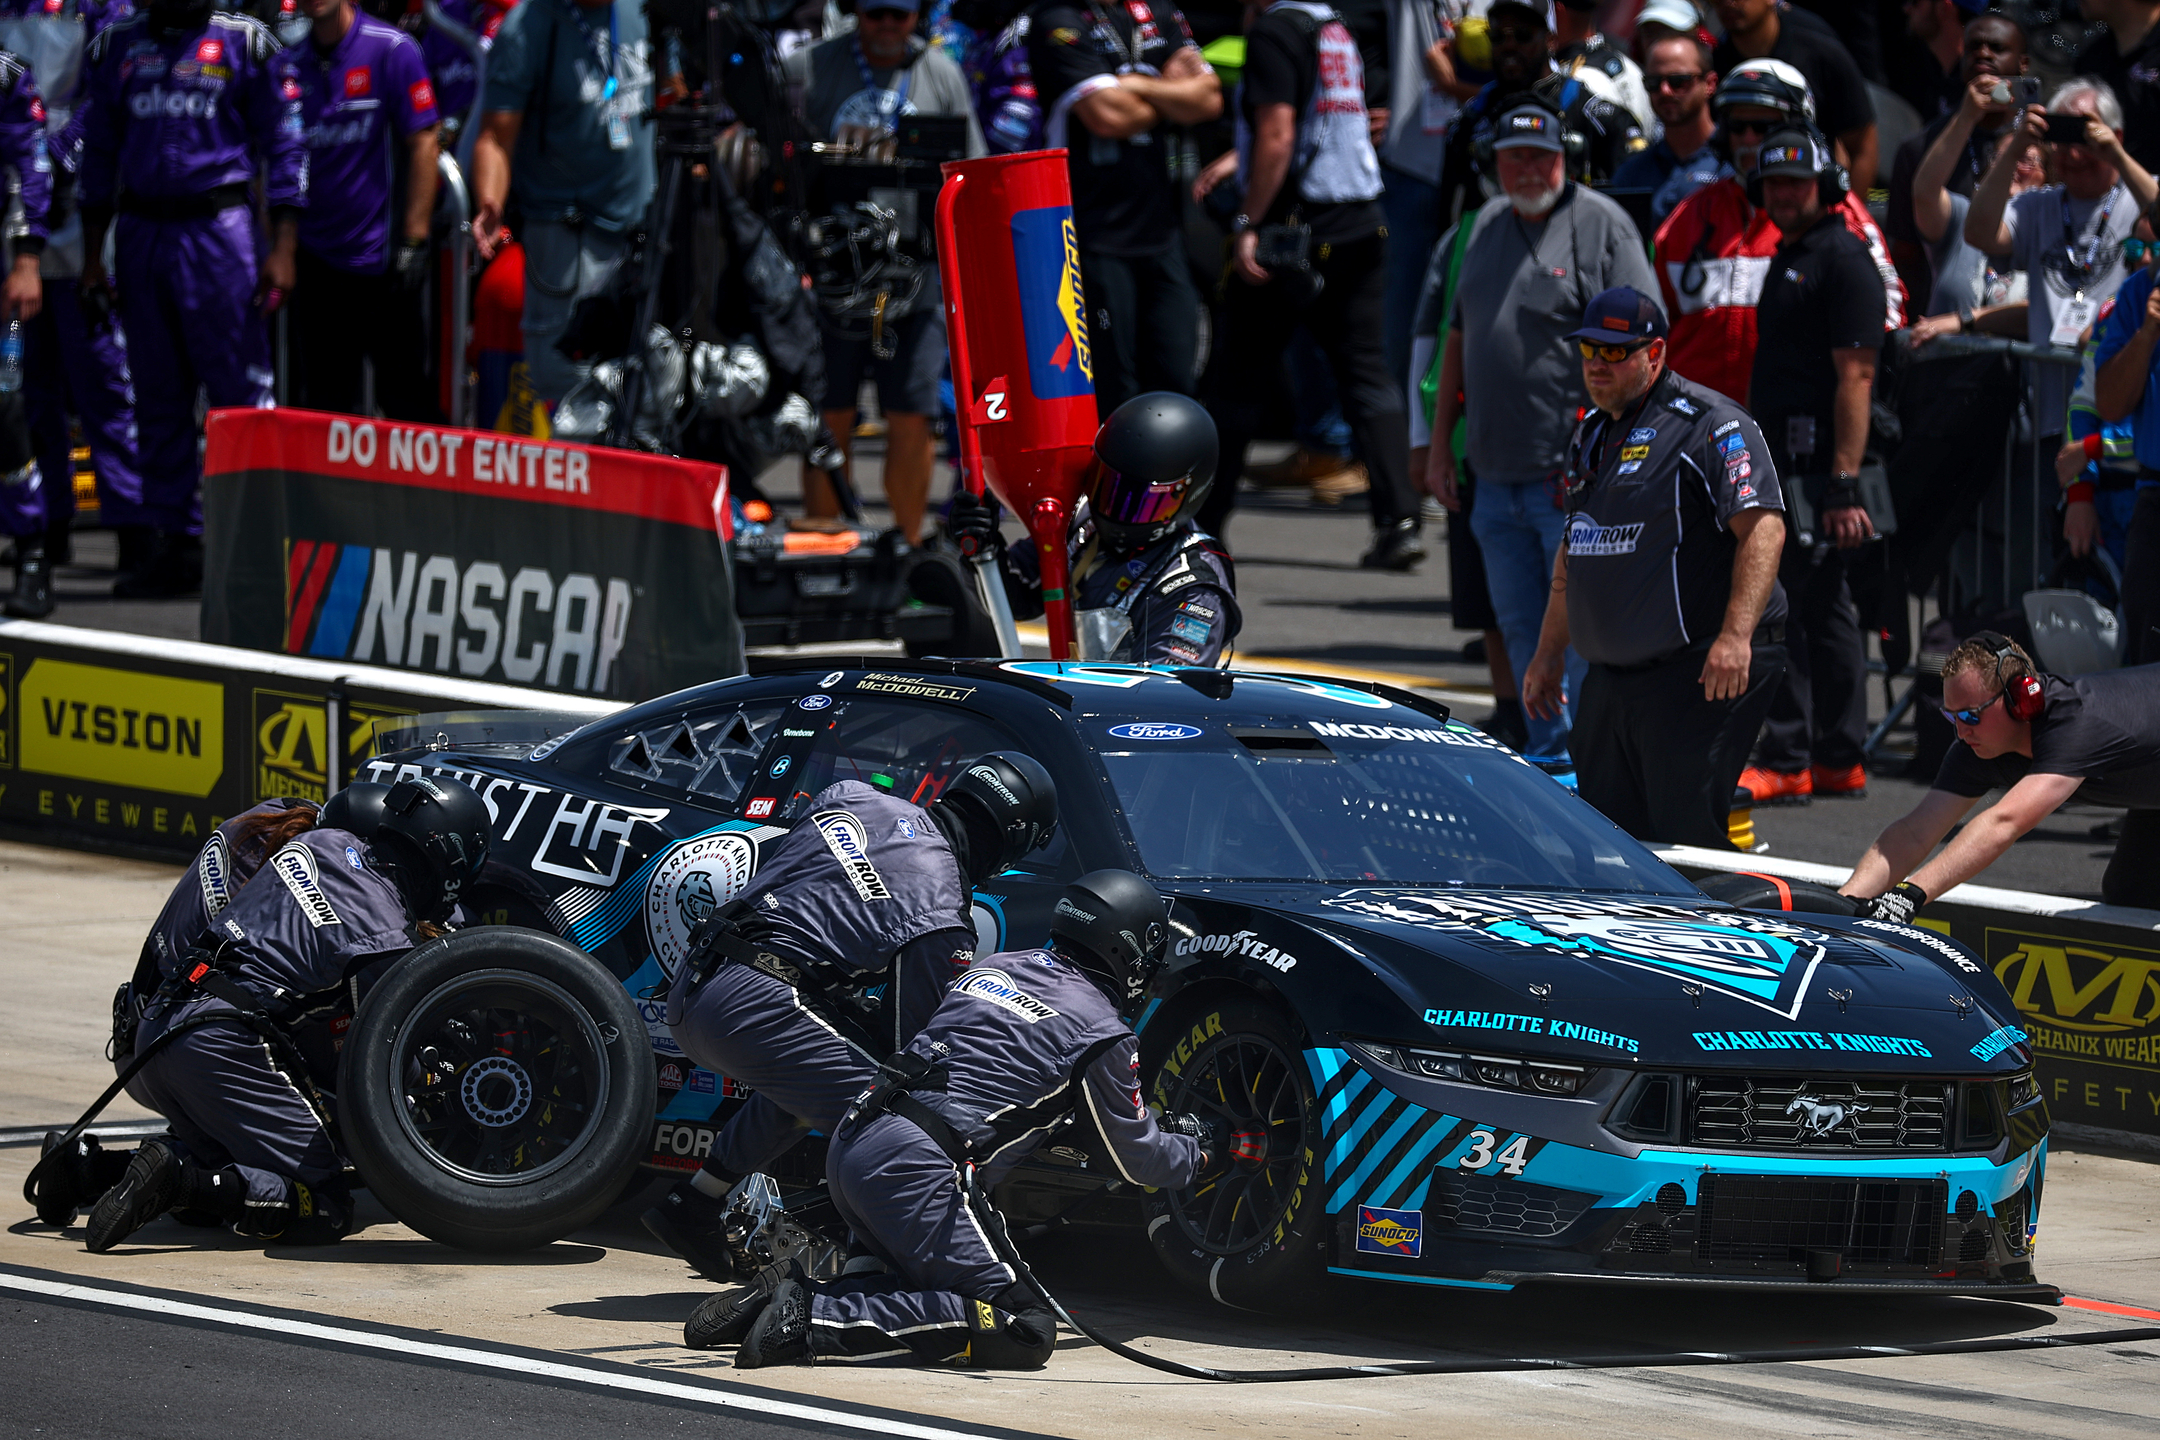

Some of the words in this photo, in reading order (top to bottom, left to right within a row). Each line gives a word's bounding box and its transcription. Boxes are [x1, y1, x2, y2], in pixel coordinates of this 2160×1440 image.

[984, 392, 1007, 420] 2
[327, 419, 377, 468] DO
[389, 427, 463, 478] NOT
[472, 438, 590, 494] ENTER
[1149, 521, 1177, 541] 34
[804, 697, 826, 708] Ford
[41, 697, 202, 758] VISION
[1124, 723, 1185, 739] Ford
[1308, 721, 1495, 749] MCDOWELL
[747, 800, 774, 816] SEM
[652, 839, 734, 914] CHARLOTTE
[831, 826, 888, 897] FRONTROW
[276, 862, 322, 926] MOTORSPORTS
[282, 856, 338, 924] FRONTROW
[1175, 930, 1297, 973] GOODYEAR
[1899, 927, 1982, 973] PERFORMANCE
[967, 987, 1037, 1022] MOTORSPORTS
[972, 979, 1053, 1018] FRONTROW
[1126, 976, 1144, 999] 34
[1423, 1008, 1544, 1034] CHARLOTTE
[1548, 1019, 1640, 1053] KNIGHTS
[1691, 1029, 1831, 1052] CHARLOTTE
[1831, 1032, 1933, 1058] KNIGHTS
[660, 1066, 681, 1081] MAG
[654, 1124, 720, 1159] FOR
[1459, 1130, 1530, 1177] 34
[1360, 1224, 1420, 1243] SUNOCO
